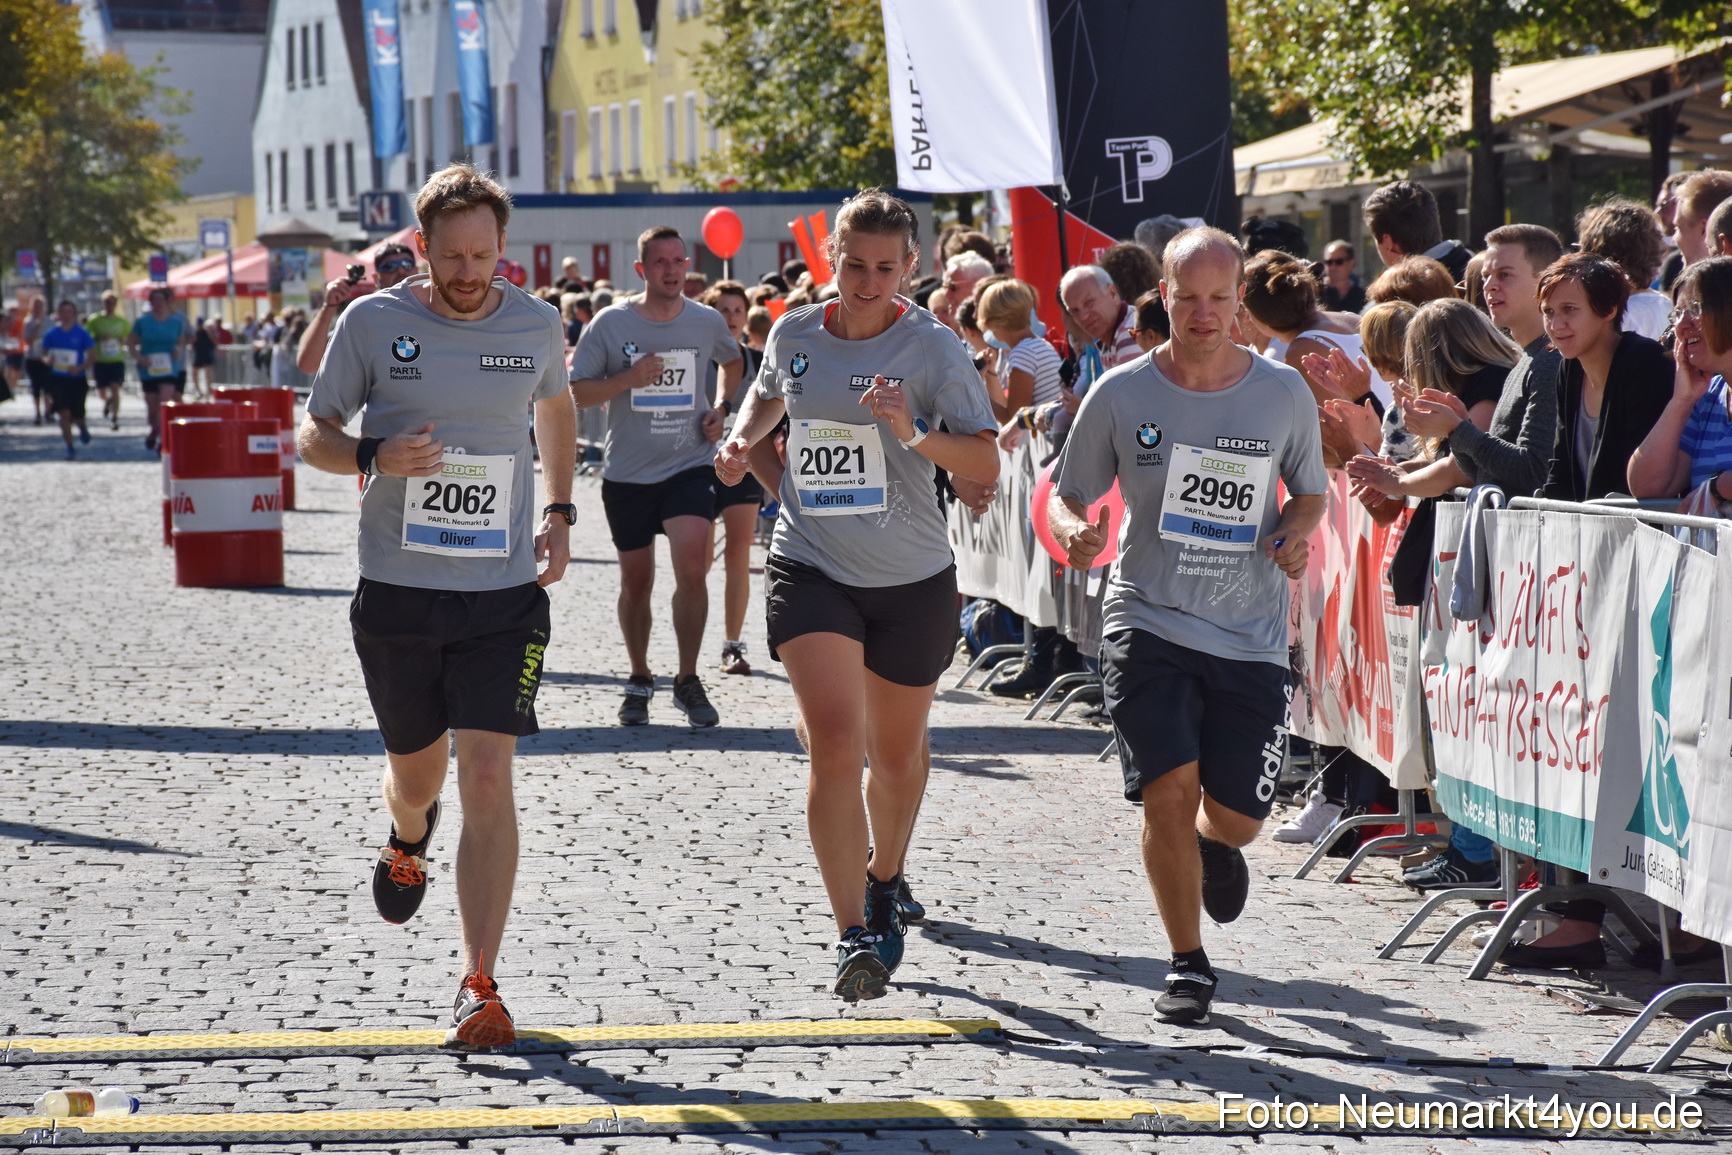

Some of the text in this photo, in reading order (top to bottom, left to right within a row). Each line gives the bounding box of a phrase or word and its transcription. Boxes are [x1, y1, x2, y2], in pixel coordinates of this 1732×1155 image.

[481, 355, 534, 368] BOCK
[390, 367, 422, 375] PARTL
[850, 376, 903, 388] BOK
[651, 418, 688, 427] Neumarkter
[809, 428, 853, 439] BOCK
[1216, 437, 1269, 452] BOCK
[800, 445, 865, 476] 2021
[1137, 453, 1163, 461] PARTL
[442, 463, 487, 476] BOCK
[1201, 457, 1247, 475] BOCK
[422, 480, 496, 515] 2062
[815, 492, 854, 505] Karina
[1180, 473, 1255, 512] 2996
[428, 516, 482, 526] PARTL Neumarkt
[1184, 506, 1237, 522] PARTL Neumarkt
[1191, 521, 1233, 540] Robert
[440, 531, 476, 546] Oliver
[1179, 551, 1240, 565] Neumarkter
[1176, 565, 1227, 580] Stadtlauf
